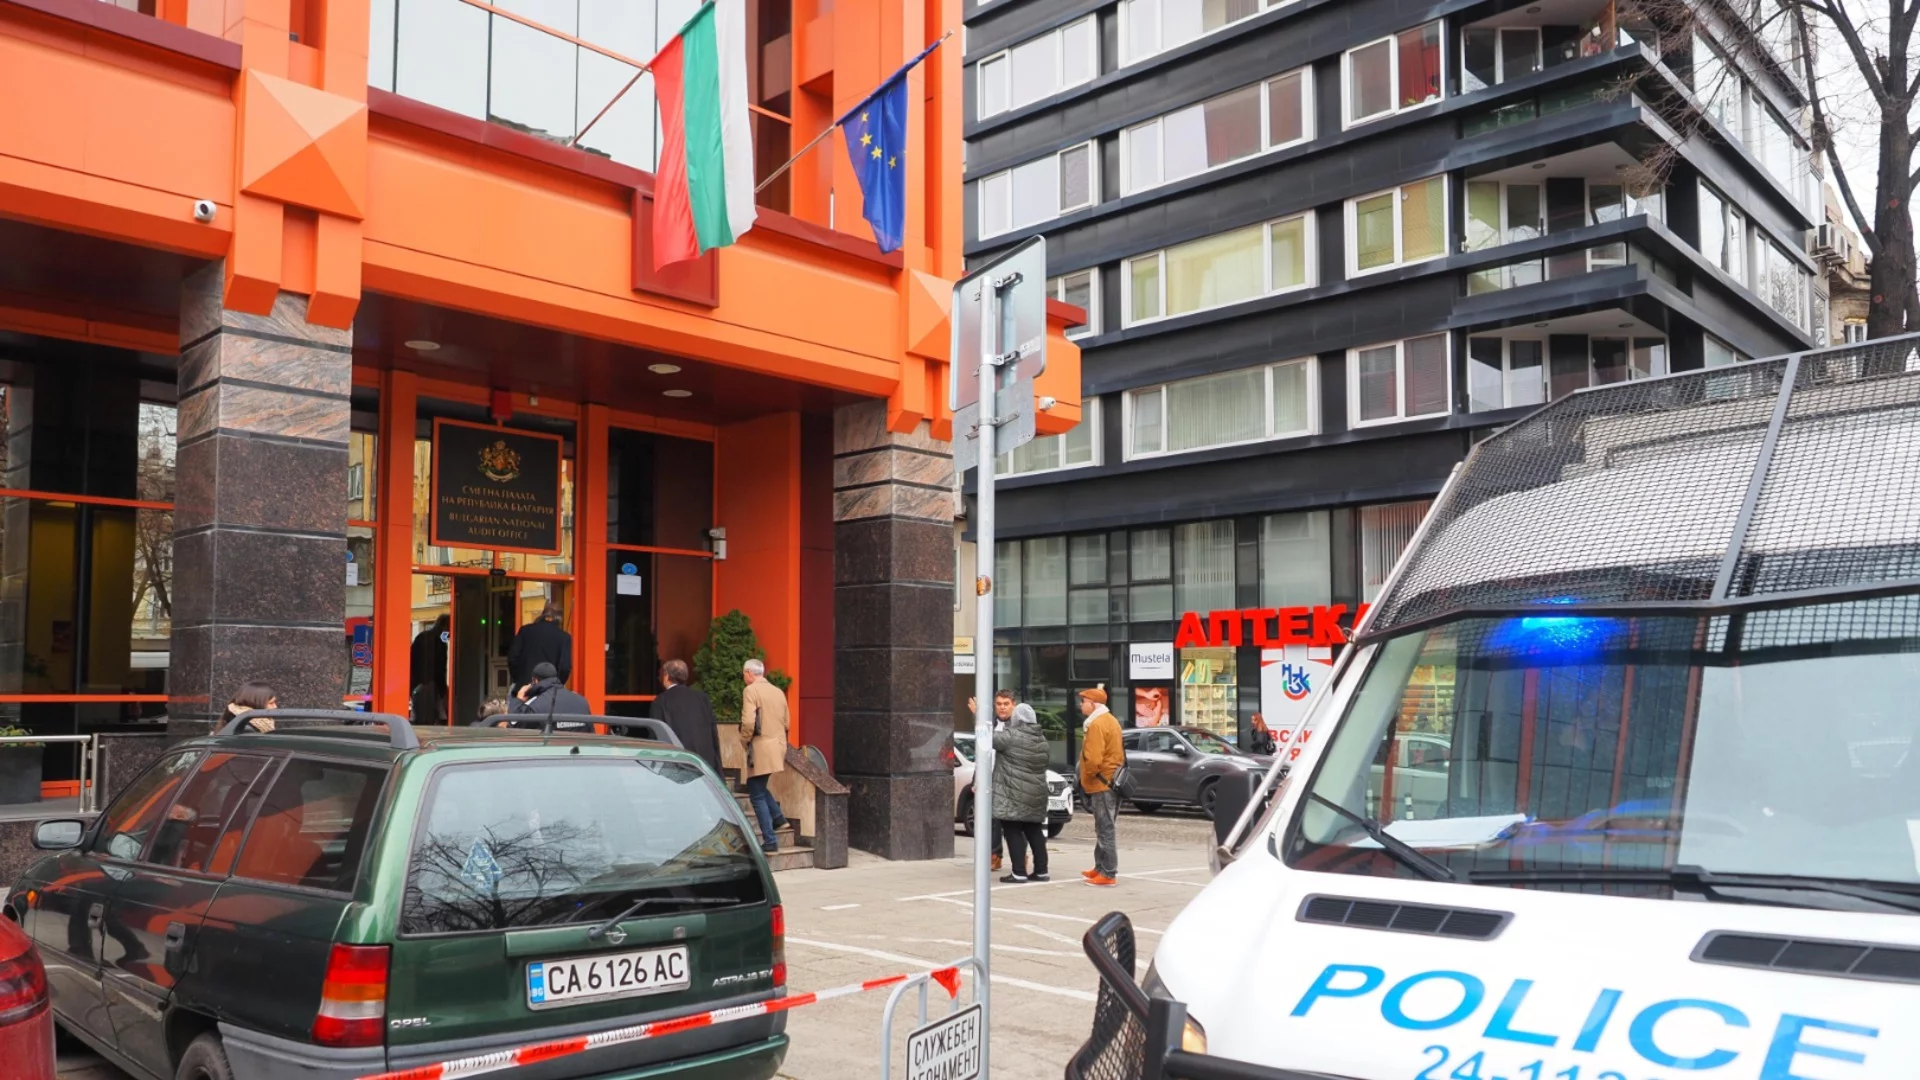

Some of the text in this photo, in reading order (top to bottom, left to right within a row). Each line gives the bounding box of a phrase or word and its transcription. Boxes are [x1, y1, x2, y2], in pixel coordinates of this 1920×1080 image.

[462, 485, 536, 501] СМЕТНА ПАЛАТА
[441, 496, 554, 516] НА РЕПУБЛИКА БЪЛГАРИЯ
[449, 512, 545, 530] BULGARIAN NATIONAL
[468, 526, 529, 540] AUDIT OFFICE
[548, 952, 684, 995] CA 6126 AC
[391, 1017, 431, 1028] OPEL
[1289, 963, 1880, 1080] POLICE
[914, 1016, 975, 1067] СЛУЖЕБЕН
